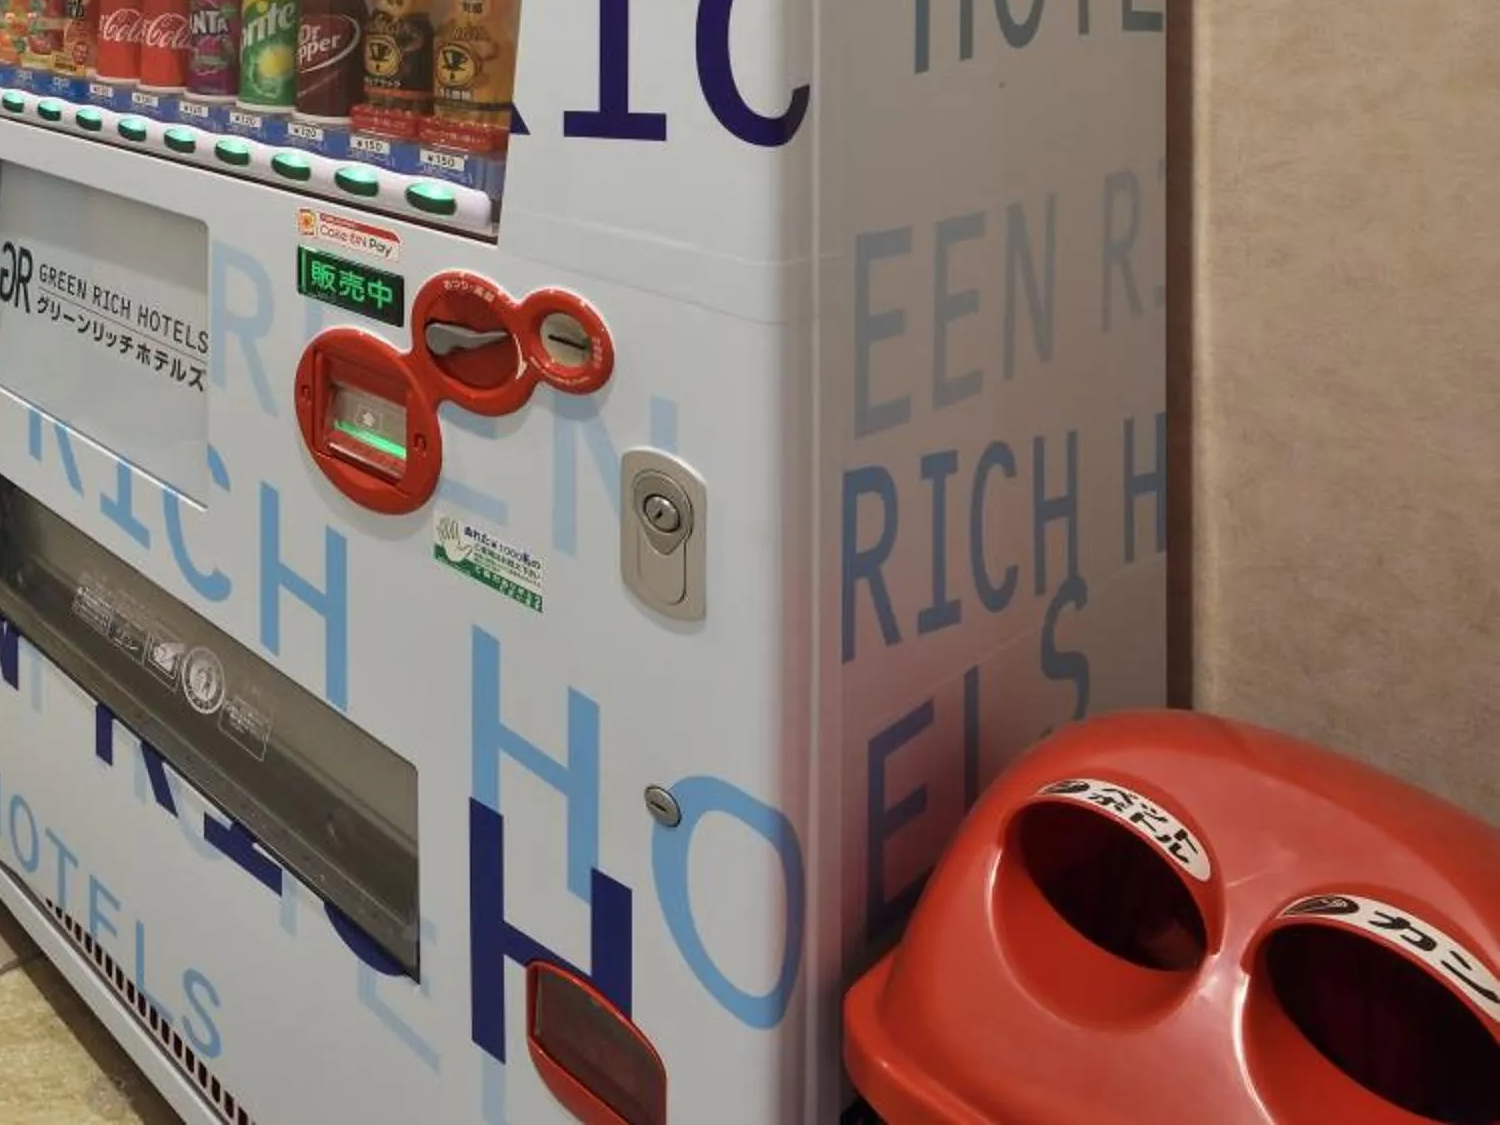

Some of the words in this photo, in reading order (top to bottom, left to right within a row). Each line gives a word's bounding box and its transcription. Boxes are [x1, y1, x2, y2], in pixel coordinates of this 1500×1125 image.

[190, 9, 229, 35] NTA
[299, 34, 341, 64] pper
[39, 262, 88, 300] GREEN
[92, 282, 132, 321] RICH
[137, 305, 209, 355] HOTELS
[311, 259, 394, 310] 販売中
[841, 429, 1080, 665] RICH
